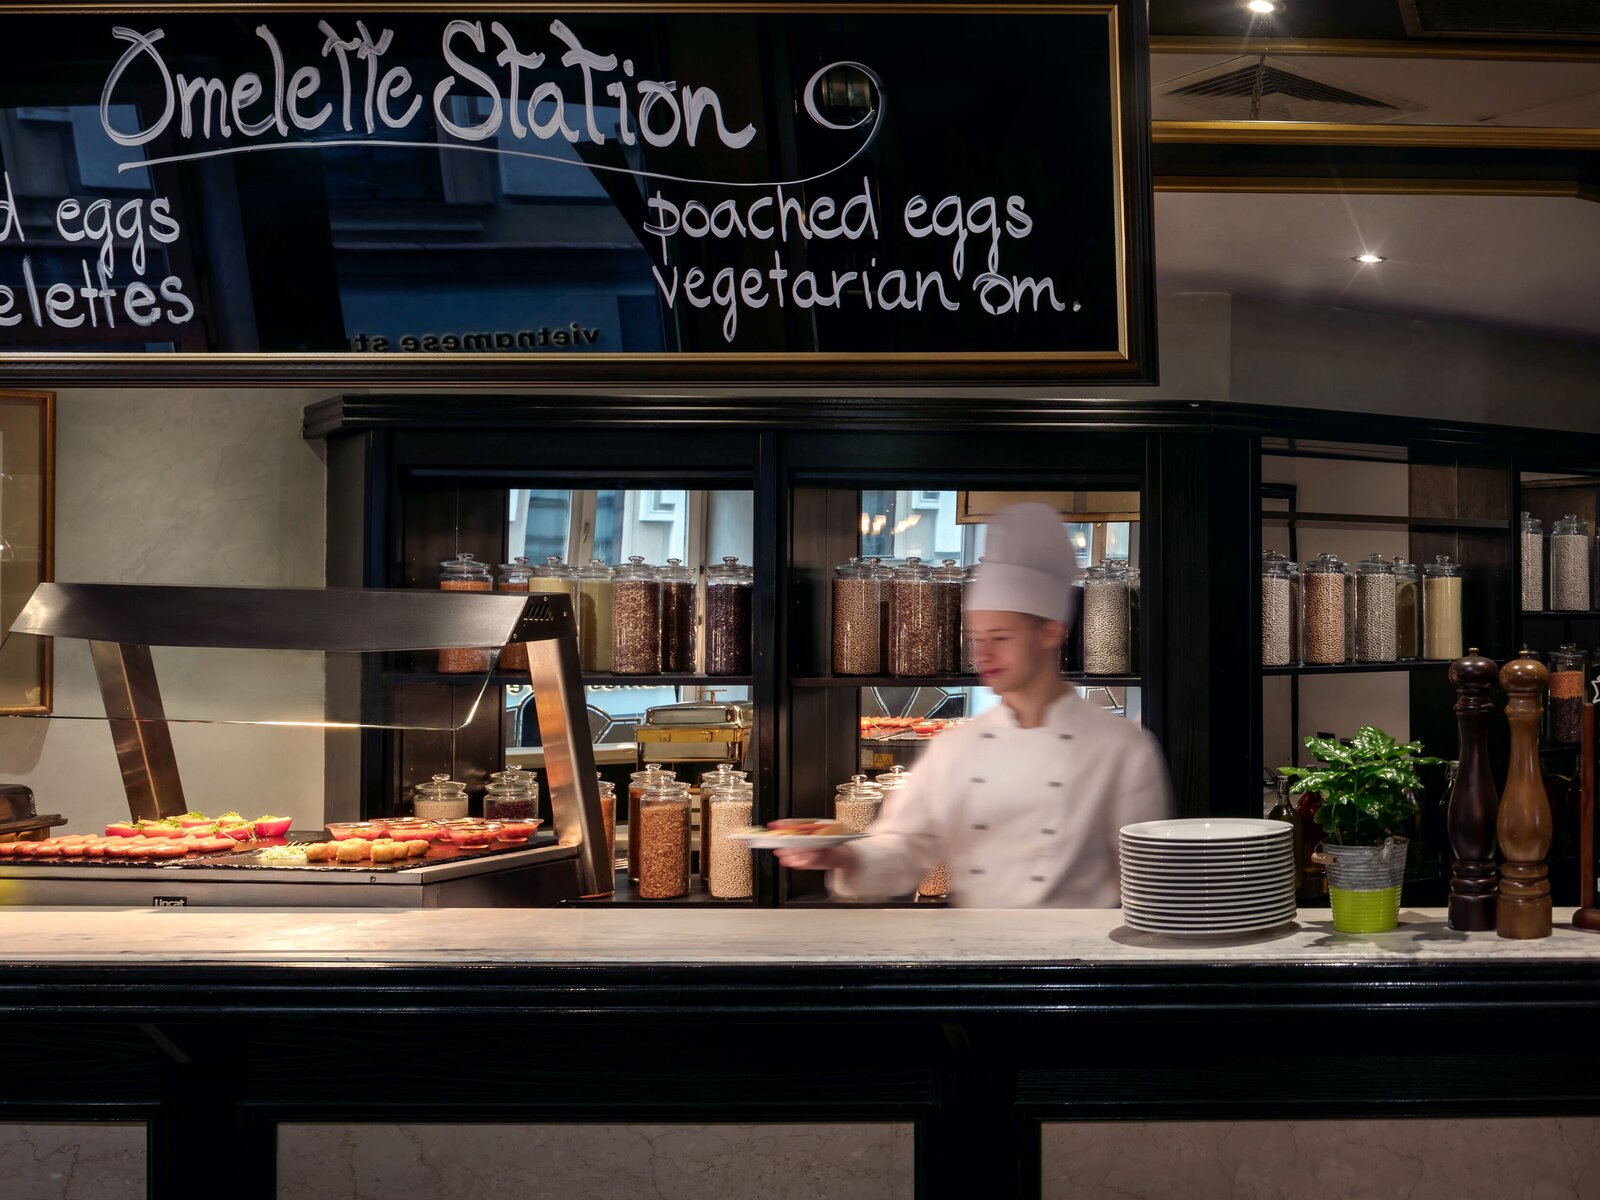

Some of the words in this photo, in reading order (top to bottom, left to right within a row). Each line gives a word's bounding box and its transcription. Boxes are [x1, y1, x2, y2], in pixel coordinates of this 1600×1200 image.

[433, 19, 757, 149] Station
[56, 197, 180, 278] eggs
[643, 176, 879, 266] poached
[904, 195, 1033, 281] eggs
[652, 250, 960, 342] vegetarian
[972, 272, 1081, 315] om.
